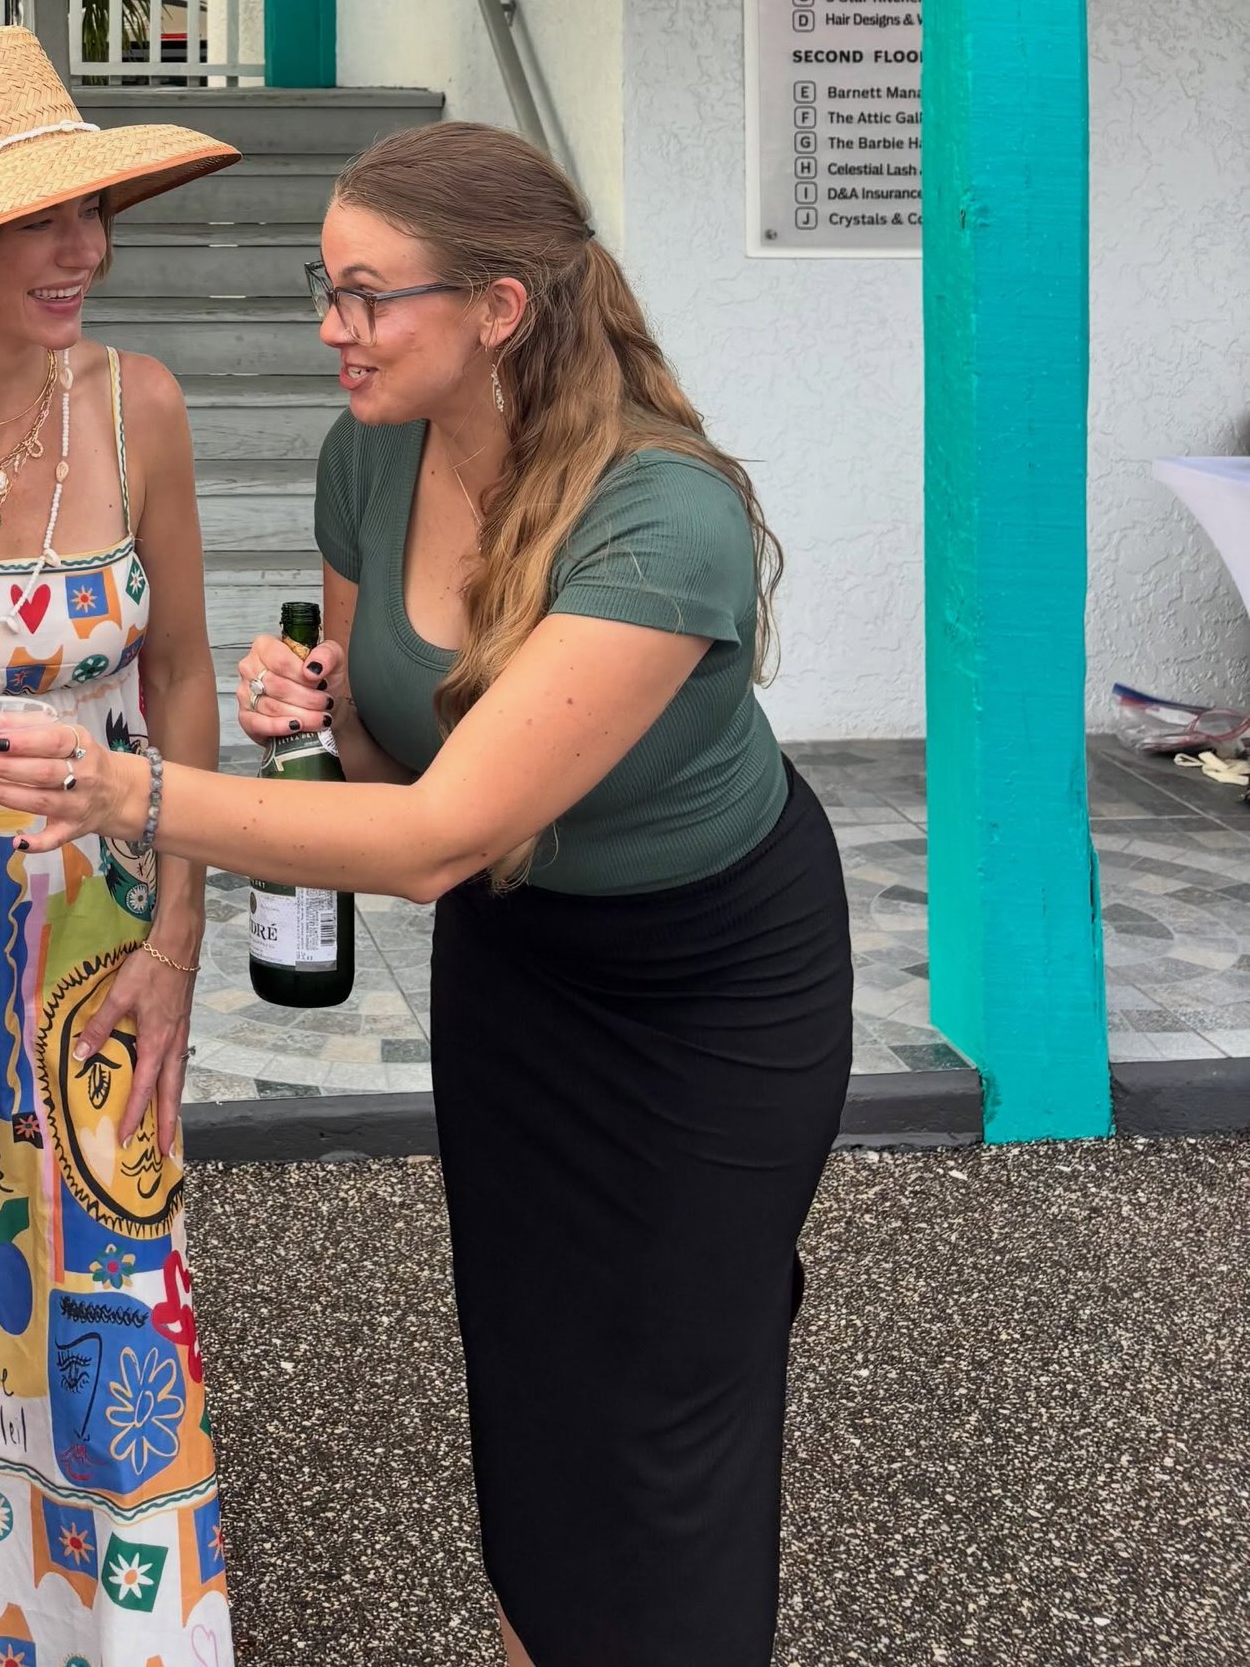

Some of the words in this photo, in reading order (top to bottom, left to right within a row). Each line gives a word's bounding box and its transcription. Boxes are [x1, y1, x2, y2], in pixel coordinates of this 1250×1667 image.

[798, 14, 809, 27] D
[825, 13, 850, 26] Hair
[853, 13, 901, 28] Designs
[903, 13, 915, 26] &
[792, 50, 864, 64] SECOND
[800, 86, 809, 99] E
[827, 86, 882, 99] Barnett
[801, 111, 810, 124] F
[828, 111, 854, 124] The
[857, 111, 892, 124] Attic
[800, 136, 811, 149] G
[828, 136, 854, 149] The
[858, 136, 904, 149] Barbie
[800, 162, 811, 174] H
[828, 162, 884, 176] Celestial
[886, 162, 917, 176] Lash
[827, 187, 859, 200] D&A
[829, 212, 887, 228] Crystals
[891, 212, 903, 225] &
